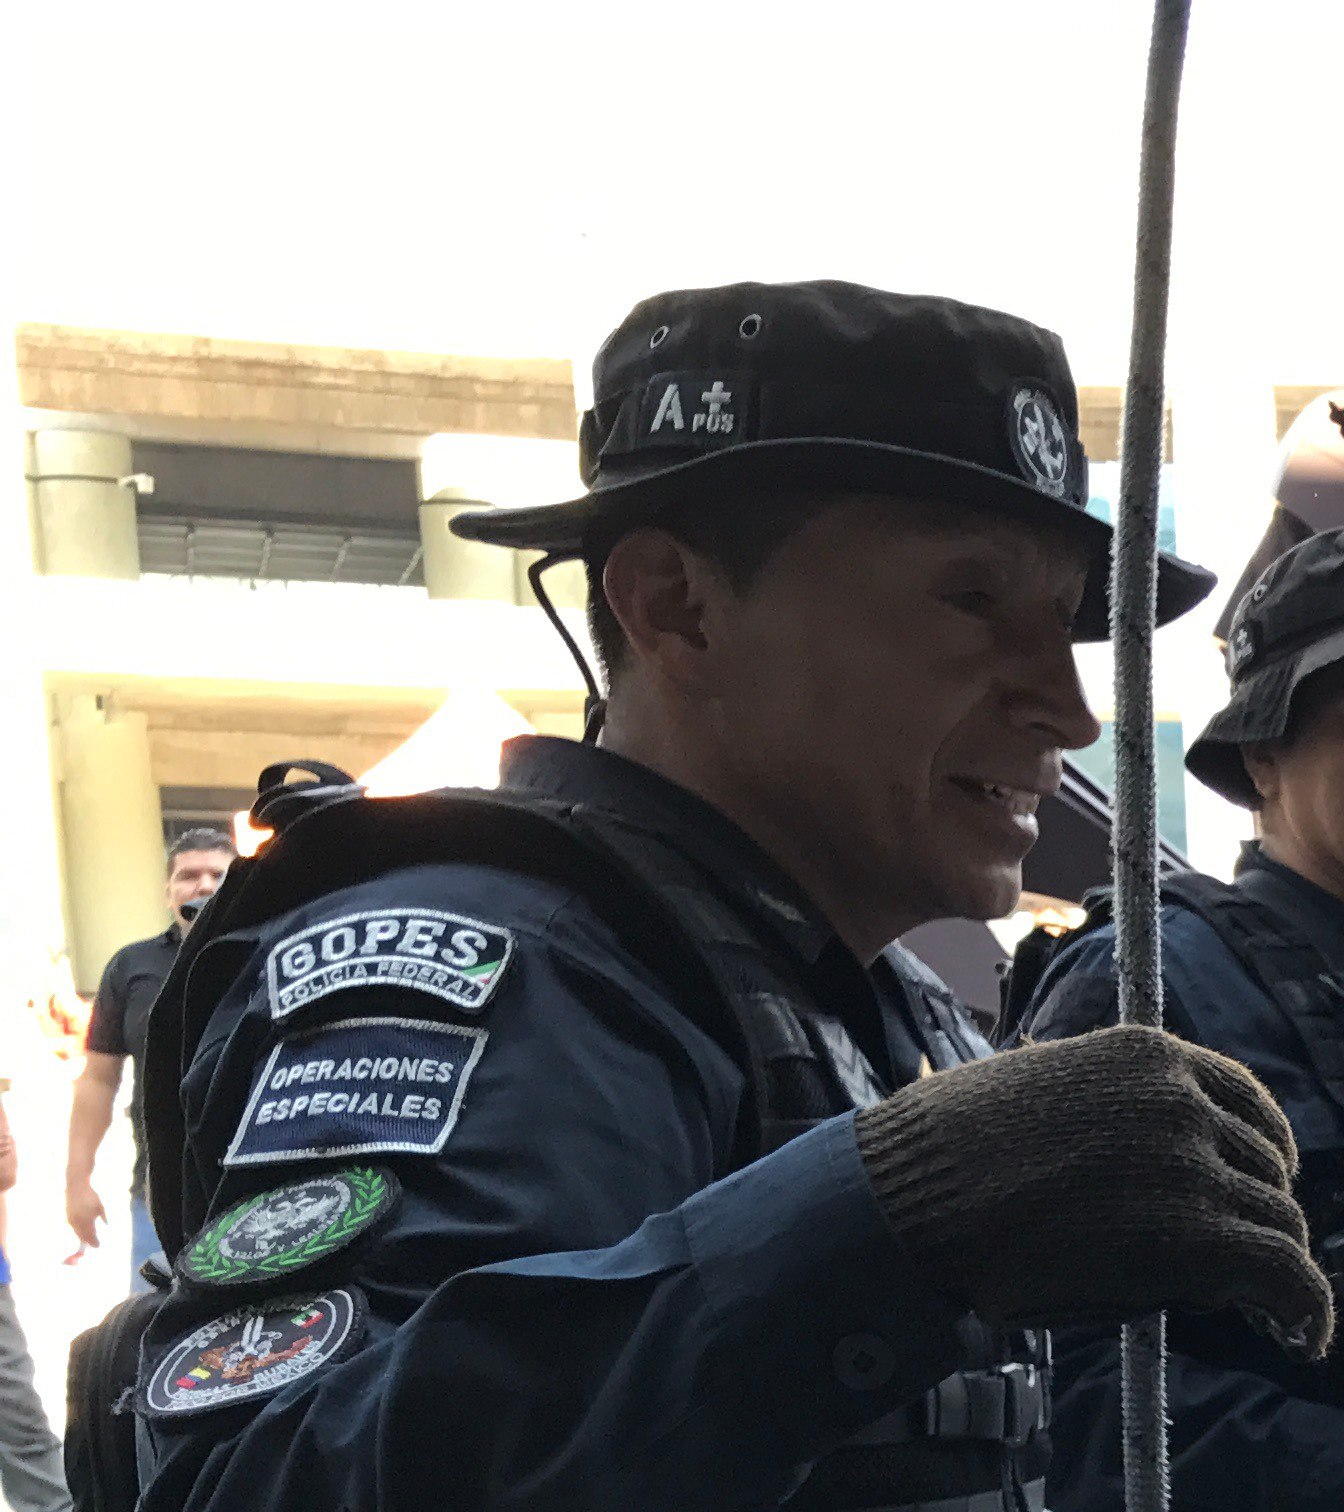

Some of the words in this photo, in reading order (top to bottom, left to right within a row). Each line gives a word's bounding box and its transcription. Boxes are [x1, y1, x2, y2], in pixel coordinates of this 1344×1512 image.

[281, 918, 488, 979] GOPES
[376, 960, 477, 1000] FEDERAL
[269, 1056, 455, 1091] OPERACIONES
[254, 1091, 442, 1126] ESPECIALES
